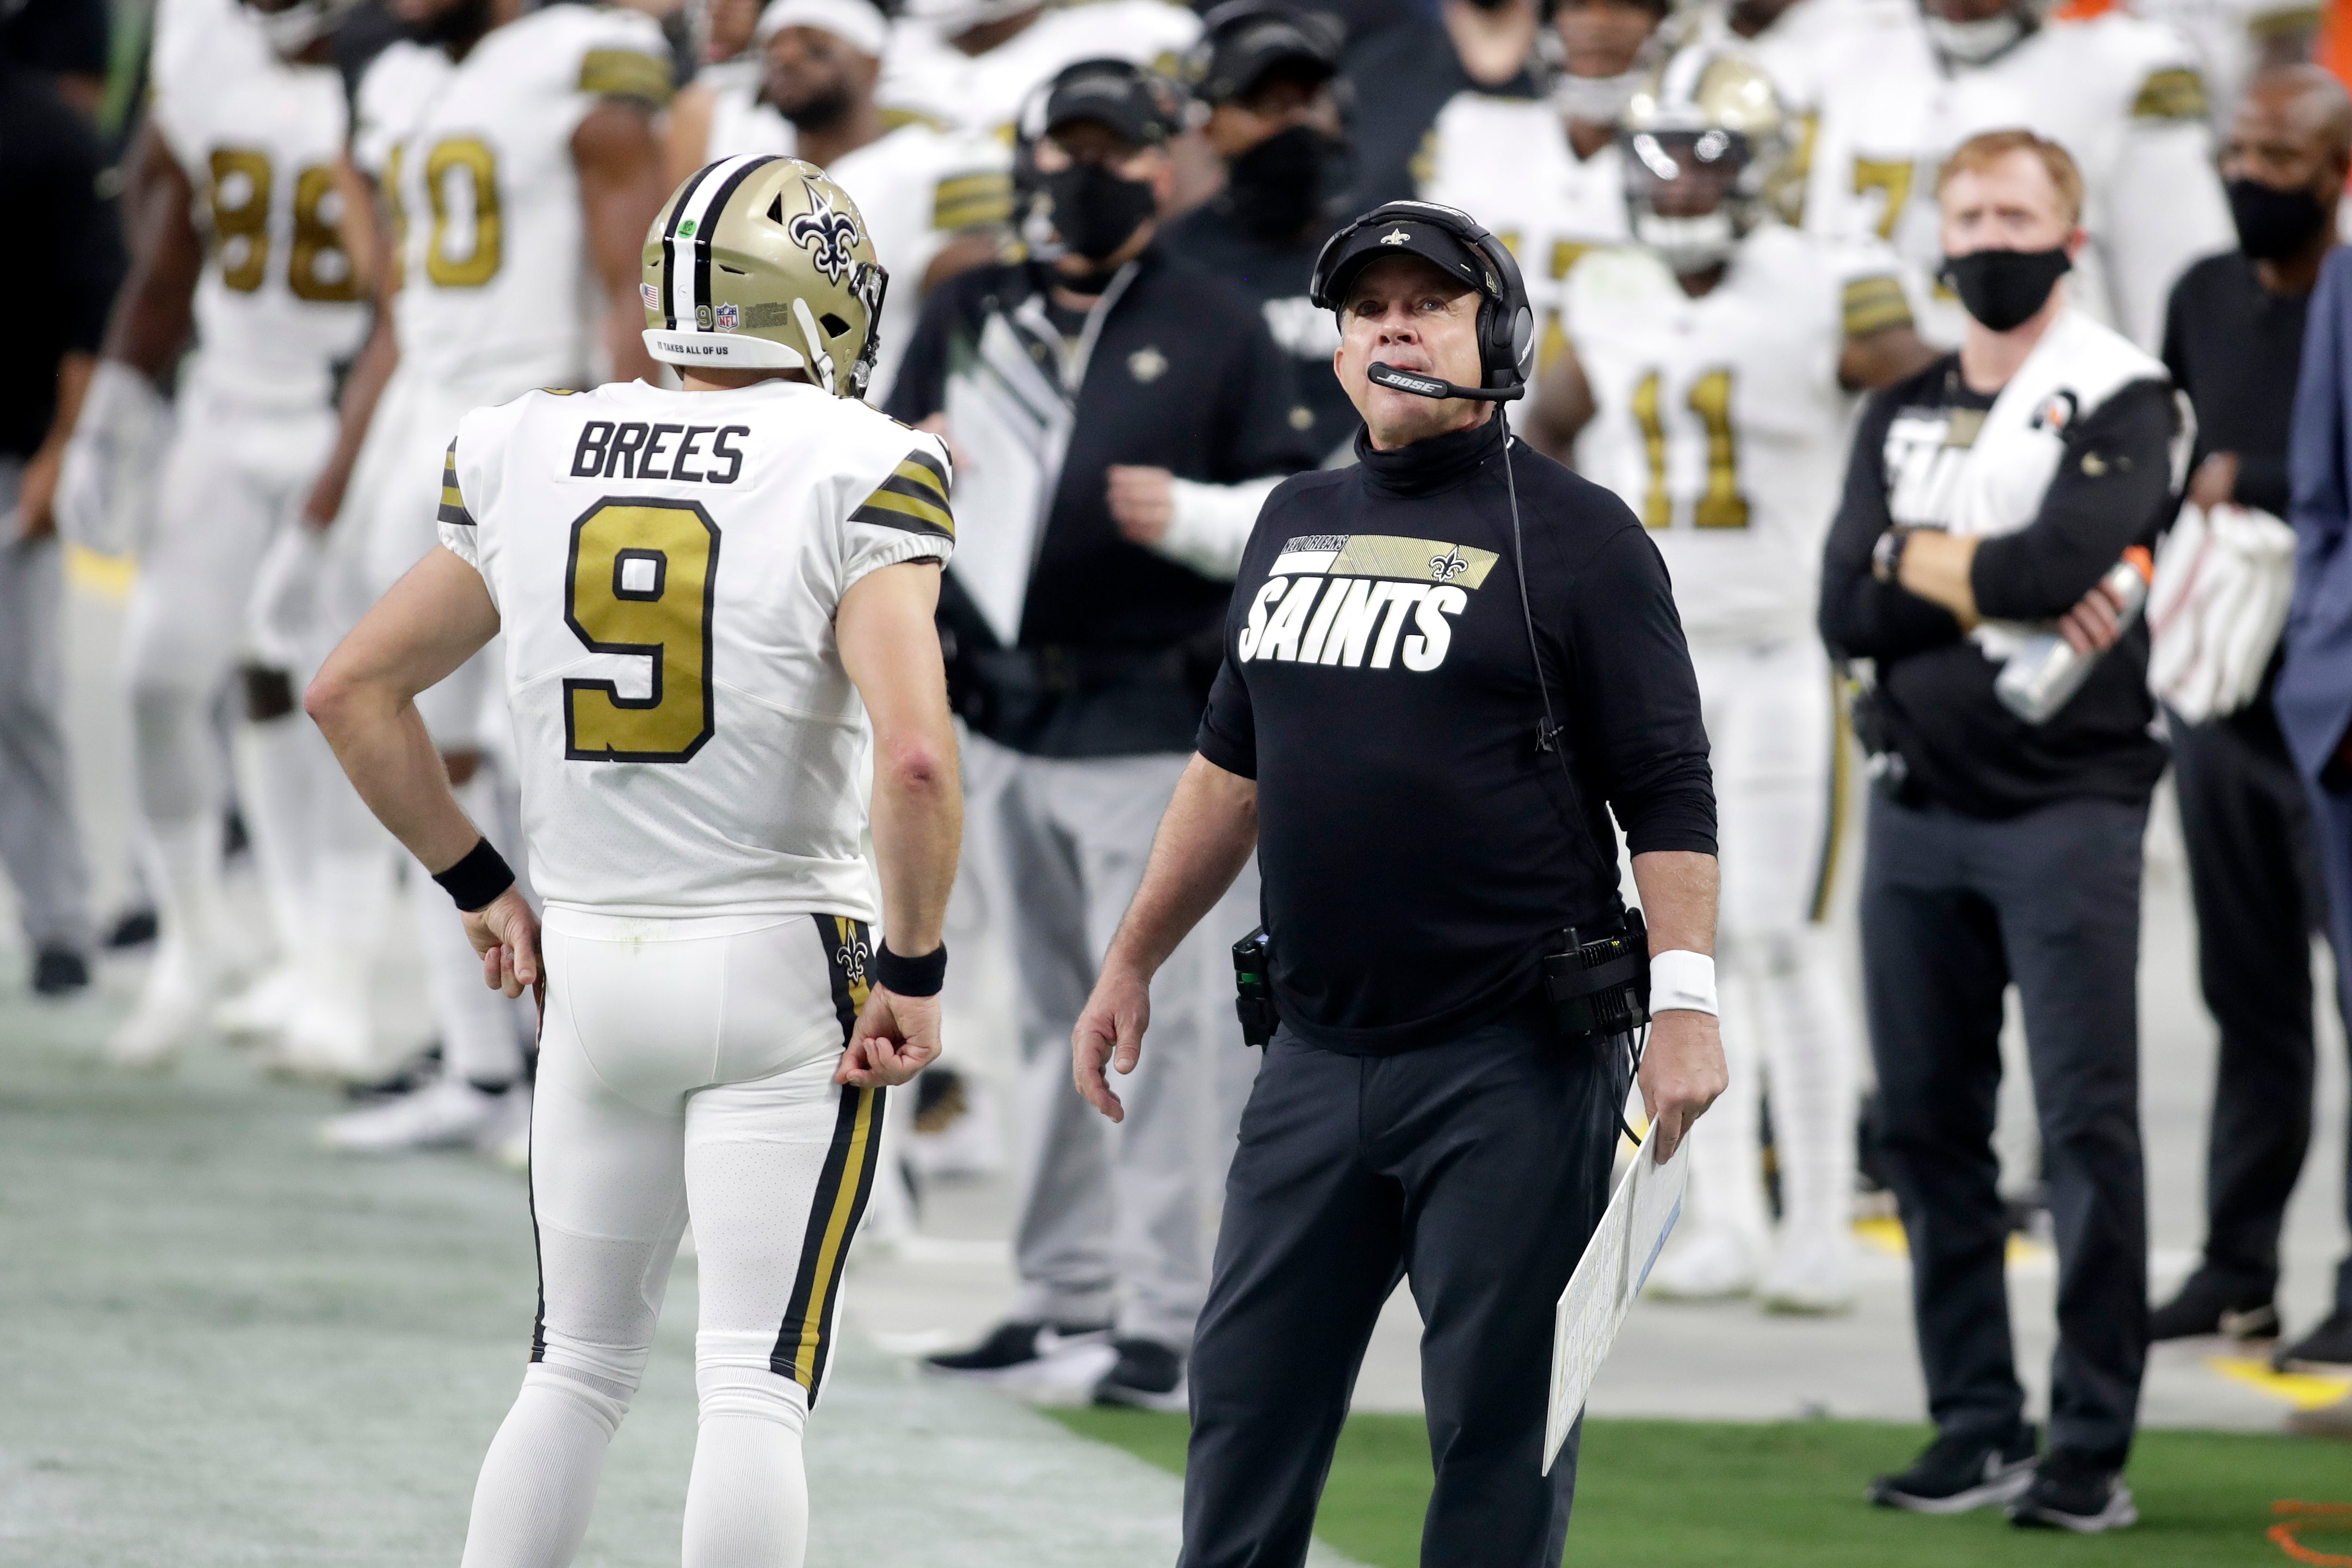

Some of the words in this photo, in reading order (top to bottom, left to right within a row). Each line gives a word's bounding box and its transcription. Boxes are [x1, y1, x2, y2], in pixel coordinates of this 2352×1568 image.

[695, 305, 713, 329] 9
[718, 315, 737, 327] NFL
[657, 341, 663, 349] IT
[663, 342, 684, 353] TAKES
[686, 345, 701, 354] ALL
[703, 346, 713, 354] OF
[716, 346, 728, 354] US
[1376, 374, 1442, 392] BOSE
[570, 421, 751, 484] BREES
[1631, 369, 1750, 529] 11
[1280, 535, 1308, 554] NEW
[1301, 534, 1349, 551] ORLEANS
[562, 495, 722, 763] 9
[1238, 576, 1468, 671] SAINTS
